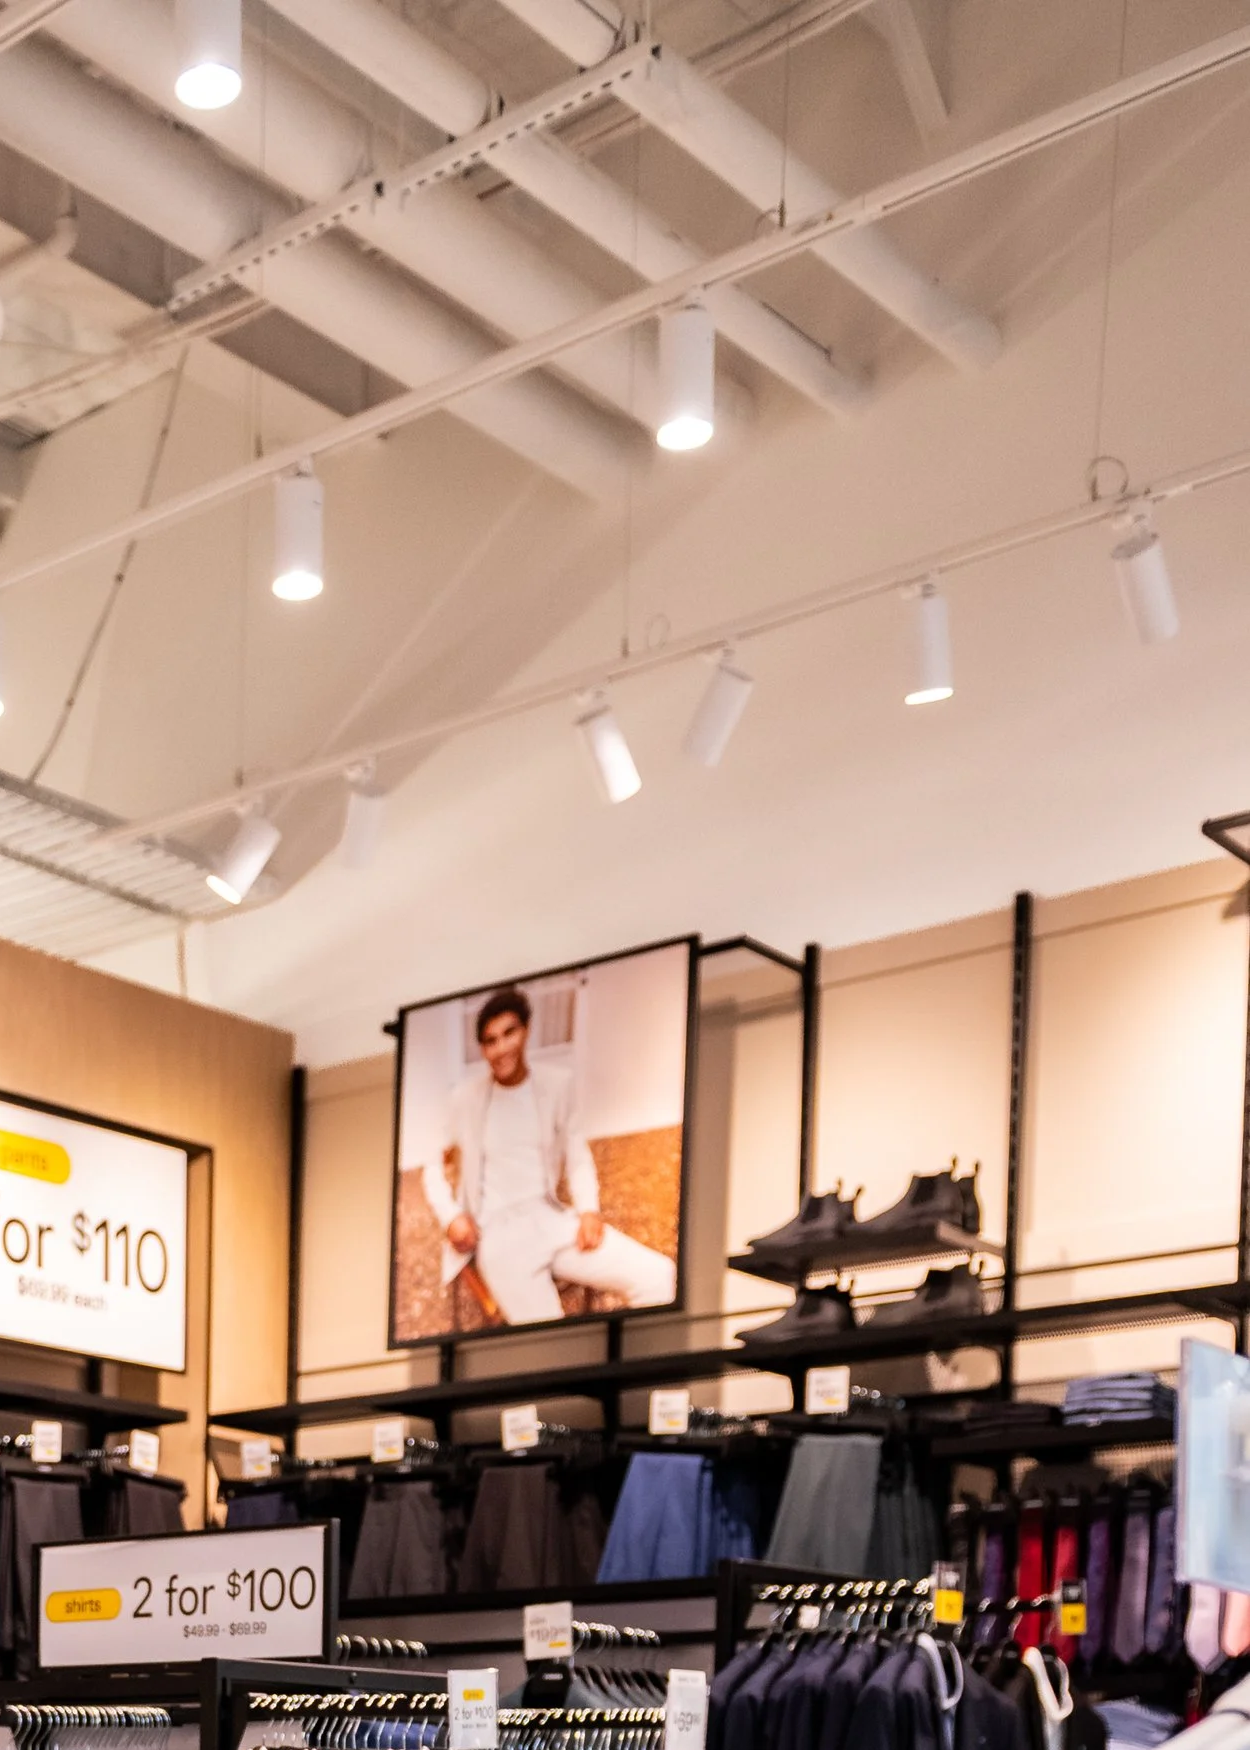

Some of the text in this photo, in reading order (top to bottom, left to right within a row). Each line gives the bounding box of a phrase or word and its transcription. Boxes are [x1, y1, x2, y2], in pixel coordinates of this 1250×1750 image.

[72, 1209, 168, 1293] $110
[65, 1596, 101, 1615] shirts
[133, 1565, 317, 1618] 2 for $100
